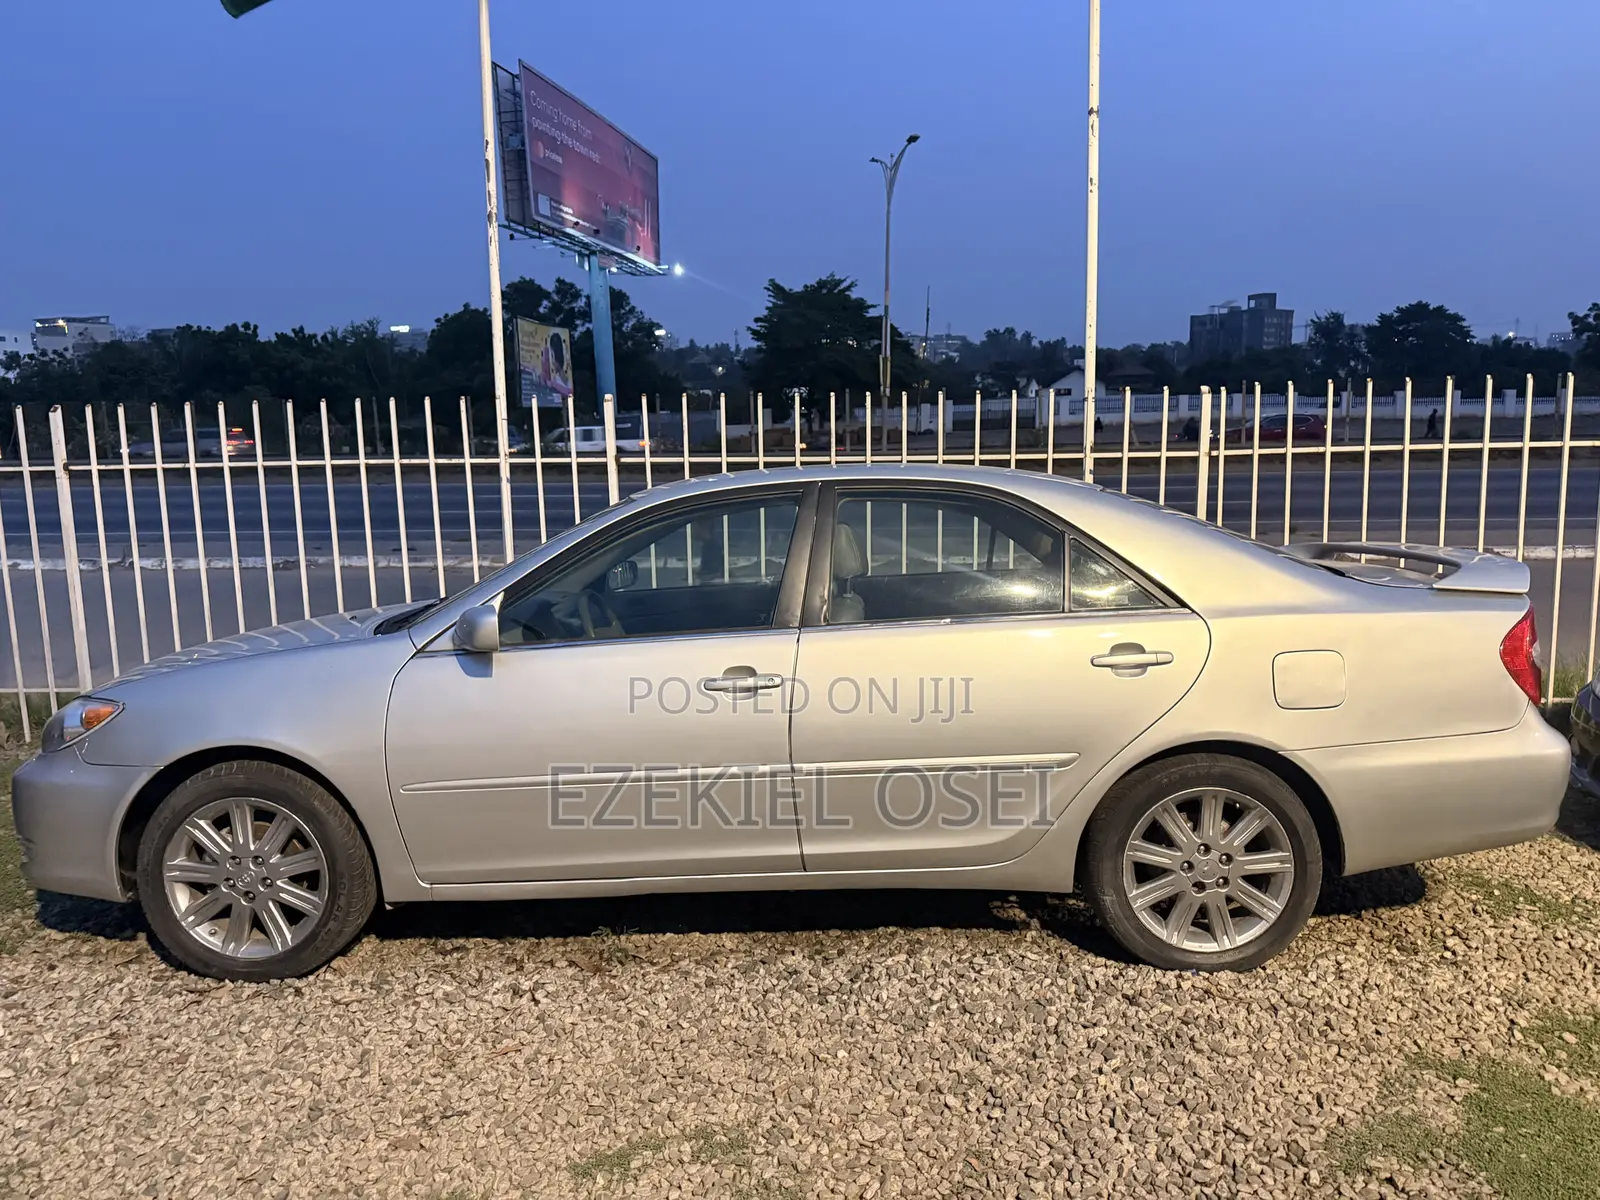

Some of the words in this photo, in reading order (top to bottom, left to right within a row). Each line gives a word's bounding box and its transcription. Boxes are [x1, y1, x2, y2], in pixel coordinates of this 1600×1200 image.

[530, 90, 558, 123] Coming
[559, 107, 577, 131] home
[577, 119, 593, 141] from
[532, 116, 561, 144] painting
[561, 131, 573, 148] the
